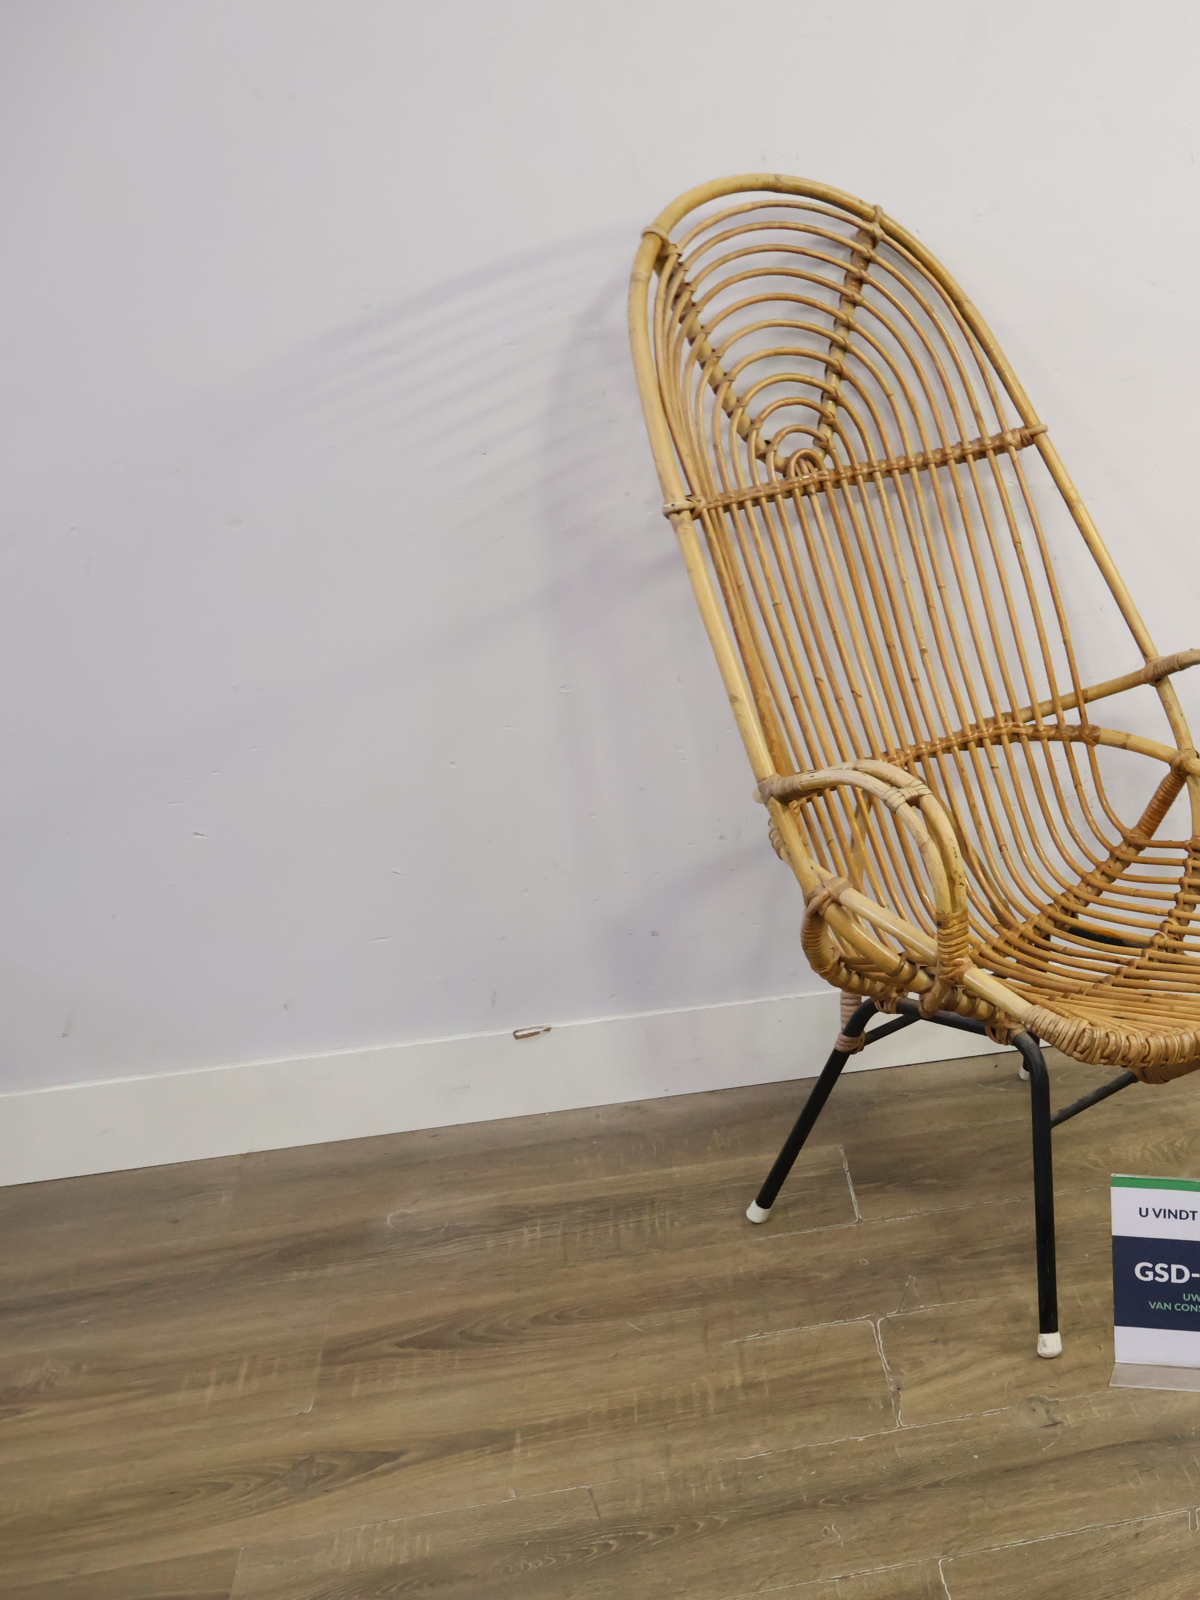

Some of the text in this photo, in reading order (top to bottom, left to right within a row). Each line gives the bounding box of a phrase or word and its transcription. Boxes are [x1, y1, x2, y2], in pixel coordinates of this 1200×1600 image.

[1138, 1207, 1149, 1218] U
[1152, 1208, 1198, 1221] VINDT
[1148, 1301, 1172, 1310] VAN
